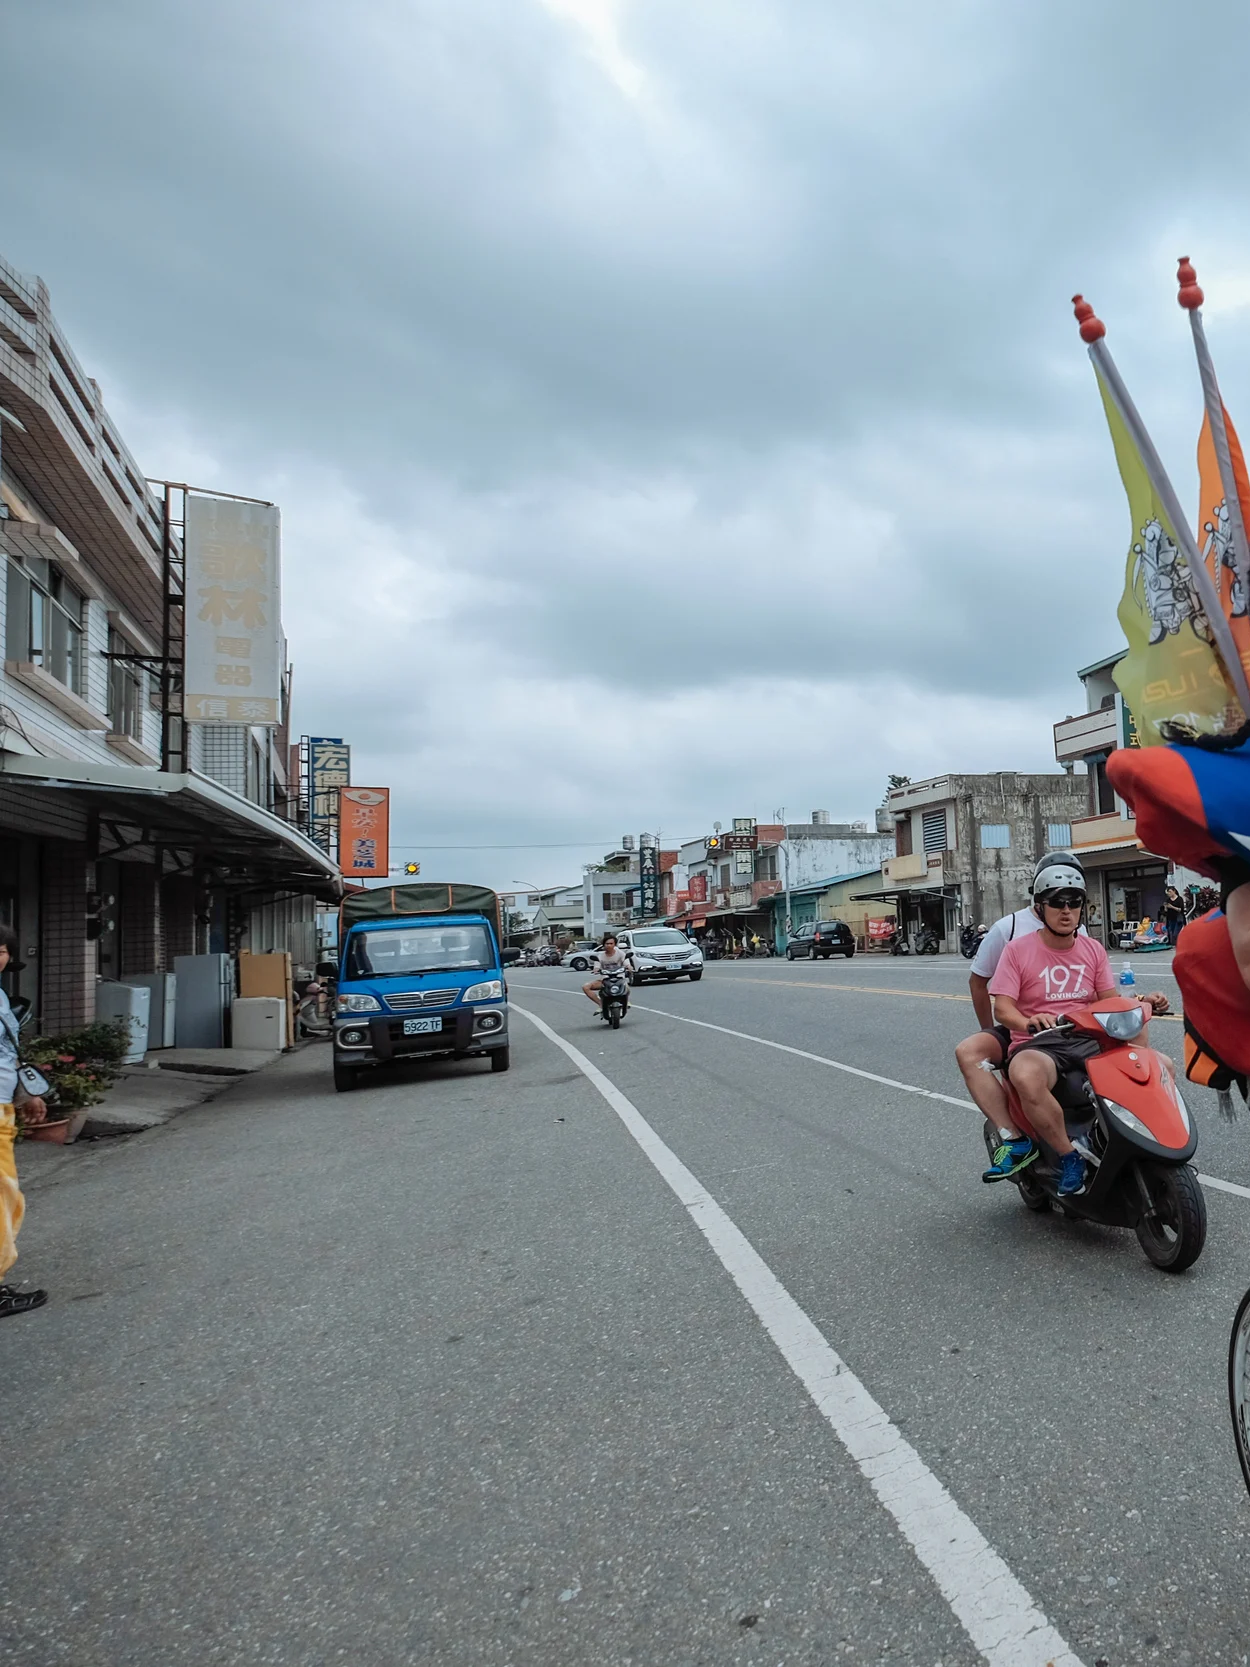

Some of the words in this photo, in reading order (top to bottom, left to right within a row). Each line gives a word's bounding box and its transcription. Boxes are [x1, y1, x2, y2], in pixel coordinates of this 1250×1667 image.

[197, 703, 270, 718] 信泰
[1039, 965, 1086, 993] 197
[1045, 992, 1080, 1000] LOVING
